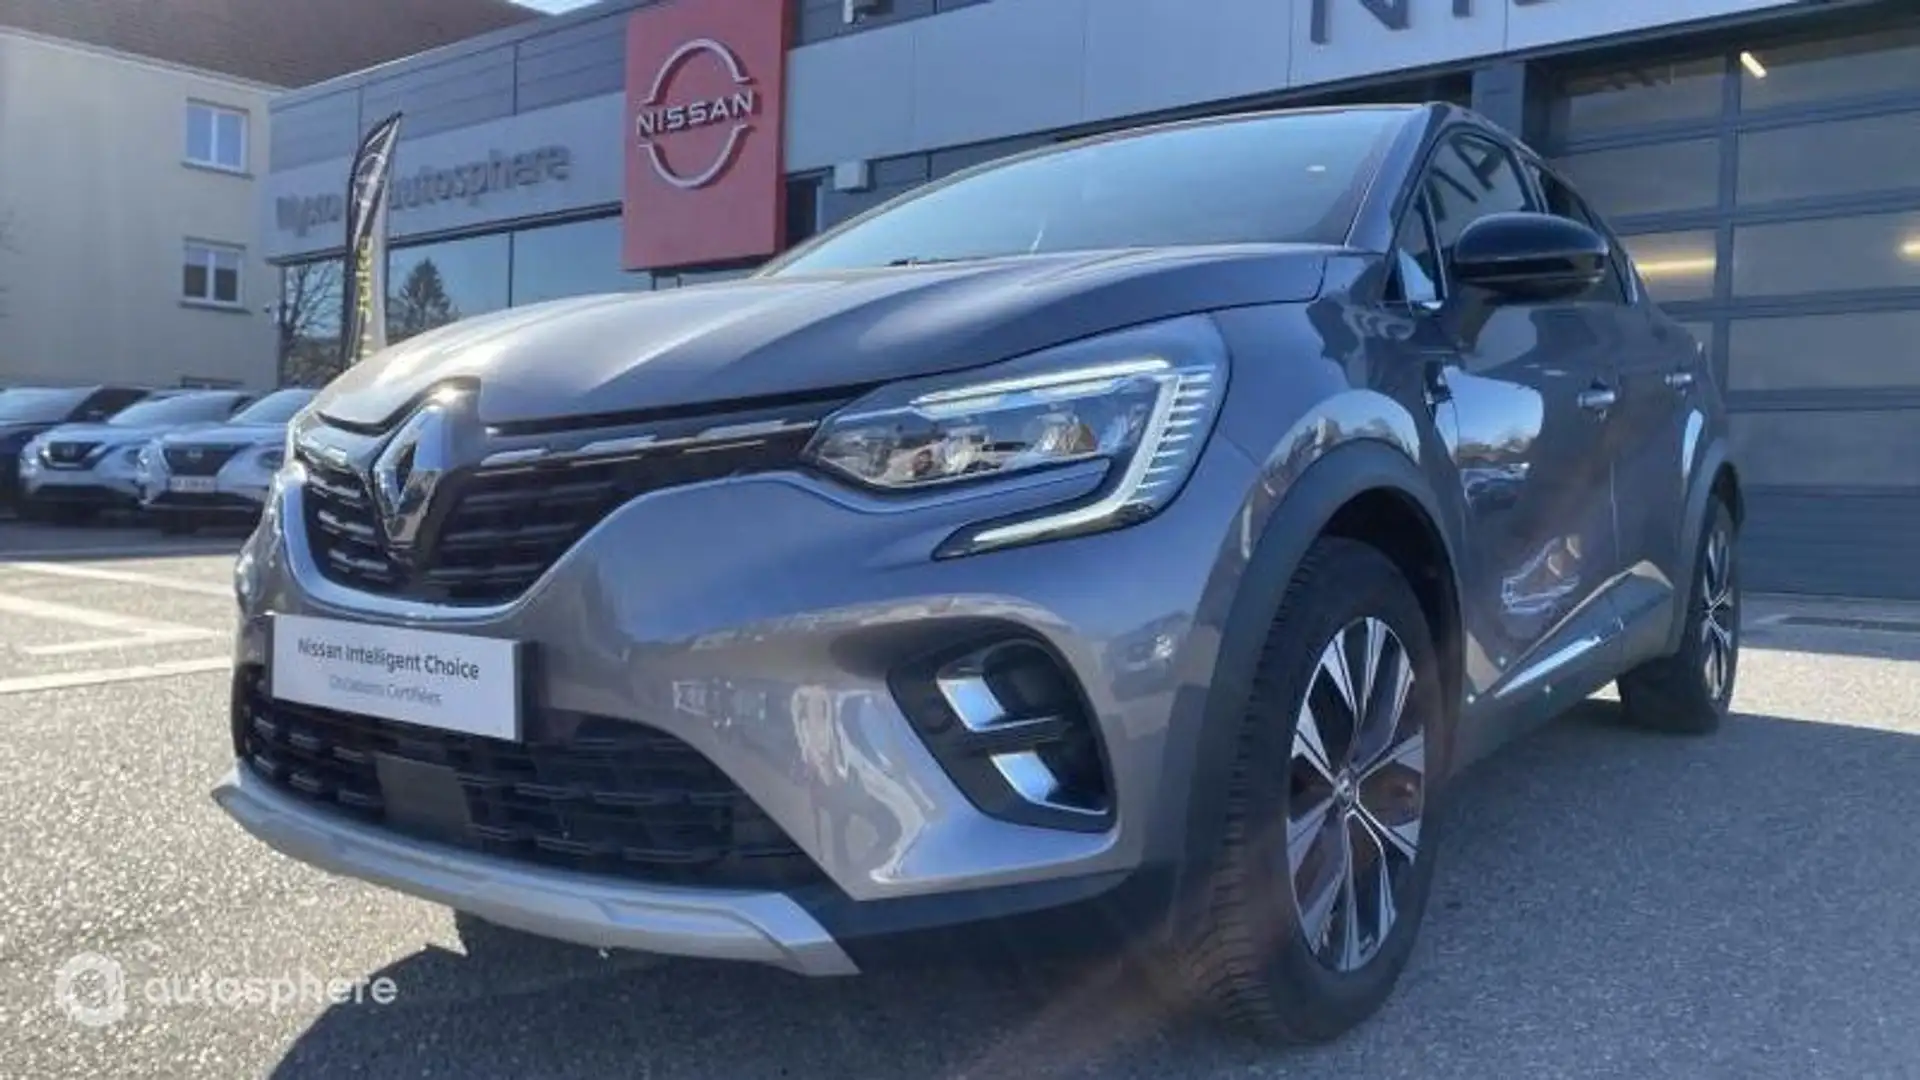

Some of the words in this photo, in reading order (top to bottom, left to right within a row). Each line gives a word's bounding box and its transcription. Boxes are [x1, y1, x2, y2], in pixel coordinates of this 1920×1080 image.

[636, 88, 753, 136] NISSAN
[297, 637, 342, 661] Nissan
[345, 644, 421, 673] Intelligent
[424, 653, 480, 681] Choice
